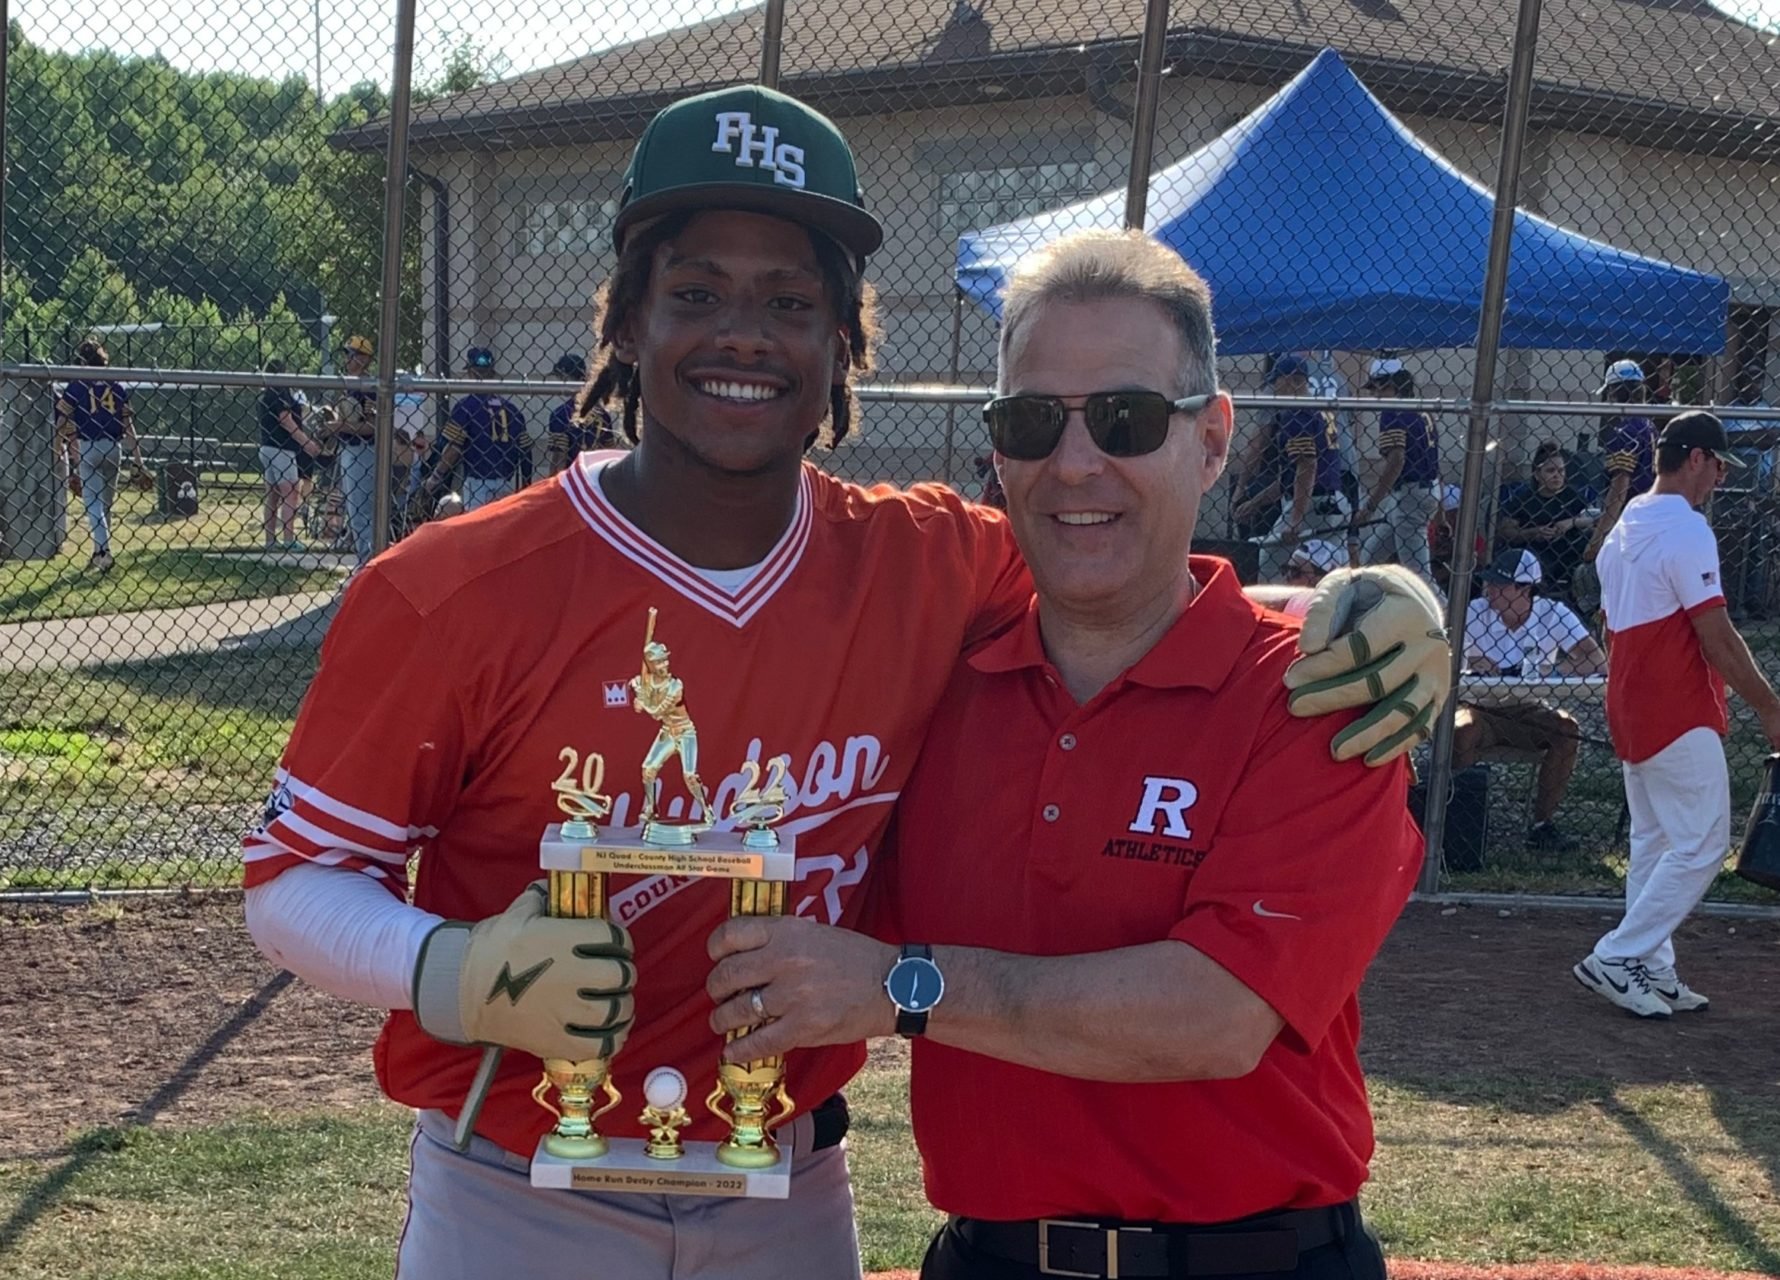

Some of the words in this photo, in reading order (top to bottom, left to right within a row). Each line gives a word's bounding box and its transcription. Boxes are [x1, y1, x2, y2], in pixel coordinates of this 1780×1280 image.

[711, 111, 806, 189] FHS
[552, 746, 605, 795] 20
[1128, 775, 1199, 841] R
[638, 853, 666, 863] County
[668, 854, 687, 864] High
[688, 855, 716, 864] School
[717, 856, 751, 865] Baseball
[573, 1173, 602, 1183] Home
[604, 1175, 624, 1184] Run
[626, 1175, 654, 1187] Derby
[656, 1176, 707, 1189] Champion
[716, 1179, 743, 1190] 2022
